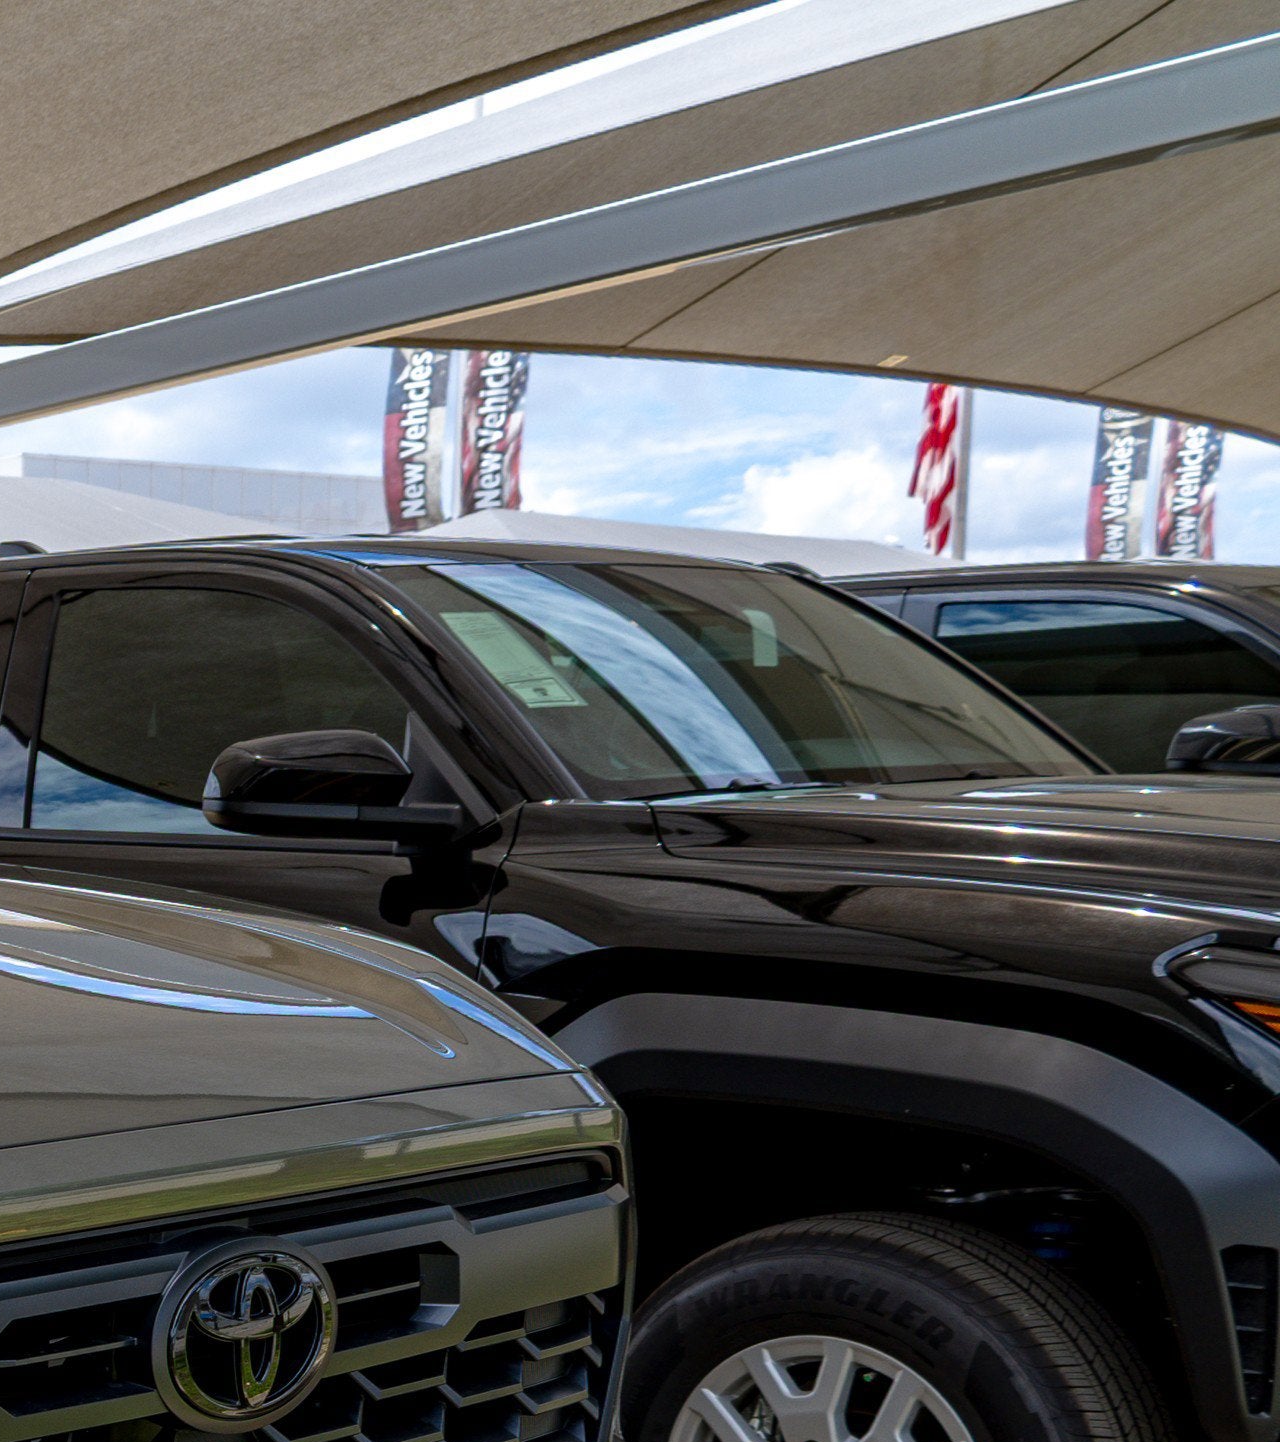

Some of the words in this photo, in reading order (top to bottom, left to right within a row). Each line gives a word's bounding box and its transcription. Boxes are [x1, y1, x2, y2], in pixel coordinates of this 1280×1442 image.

[400, 350, 434, 459] Vehicles
[476, 350, 513, 449] Vehicle
[400, 463, 427, 519] New
[473, 451, 503, 510] New
[1101, 435, 1136, 521] Vehicles
[1173, 425, 1211, 513] Vehicles
[694, 1272, 956, 1350] WRANGLER
